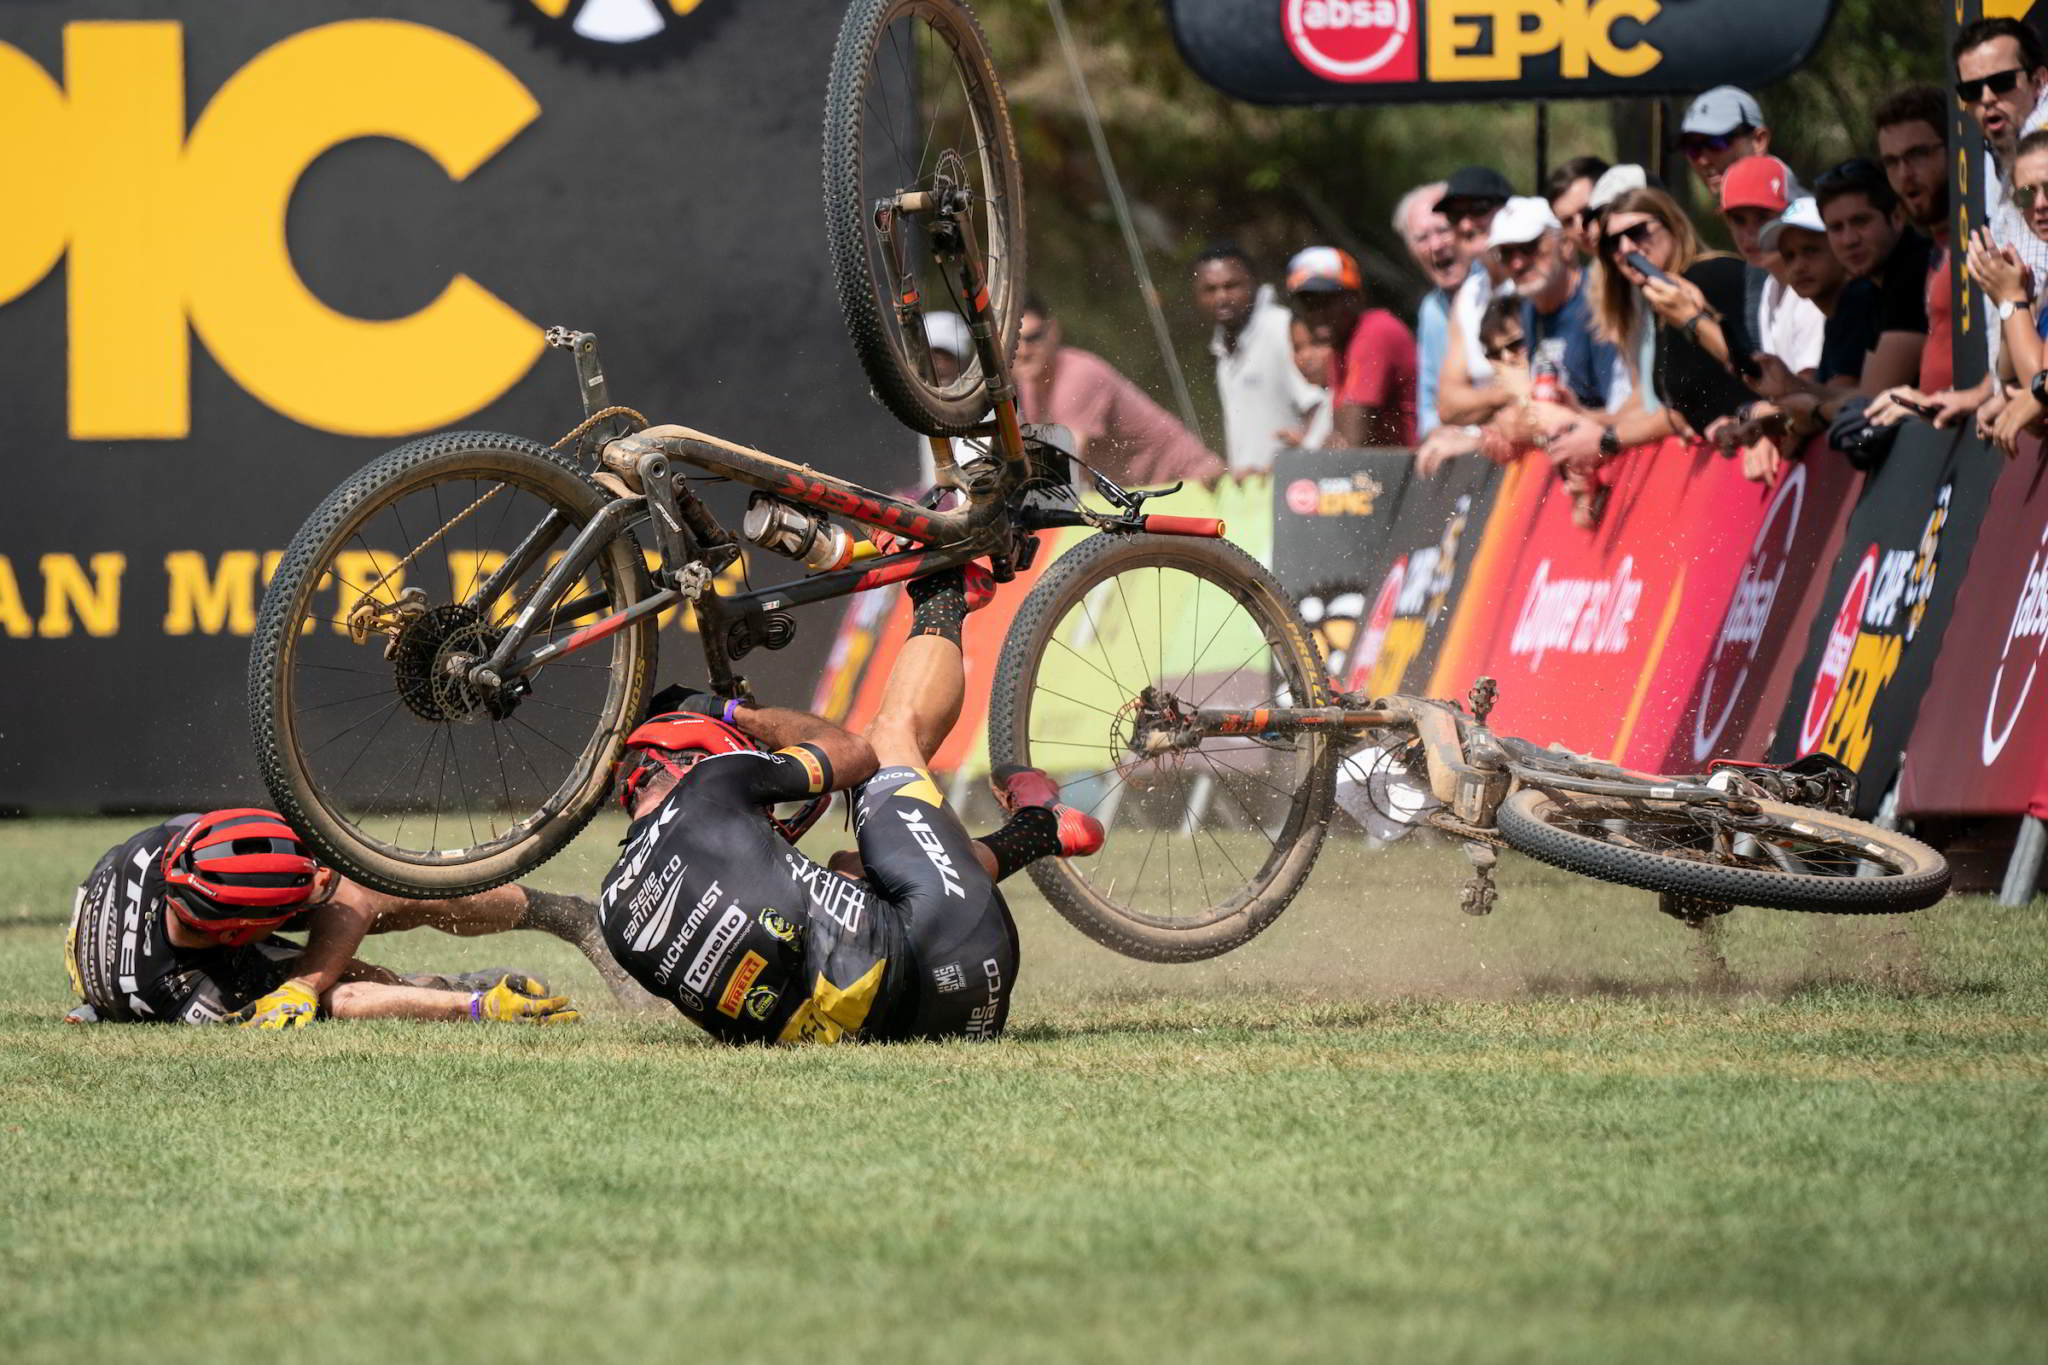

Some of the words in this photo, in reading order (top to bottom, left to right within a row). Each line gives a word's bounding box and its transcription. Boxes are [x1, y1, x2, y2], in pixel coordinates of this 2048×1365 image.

[1302, 0, 1396, 29] absa
[1427, 0, 1664, 82] EPIC
[863, 771, 917, 787] BONT
[599, 795, 681, 927] TREK
[629, 871, 657, 916] selle
[896, 808, 966, 900] TREK
[119, 845, 162, 1017] TREK
[658, 879, 724, 979] ALCHEMIST
[690, 913, 741, 986] Tonello
[721, 956, 762, 1014] PIRELLI
[981, 957, 1002, 1040] marco
